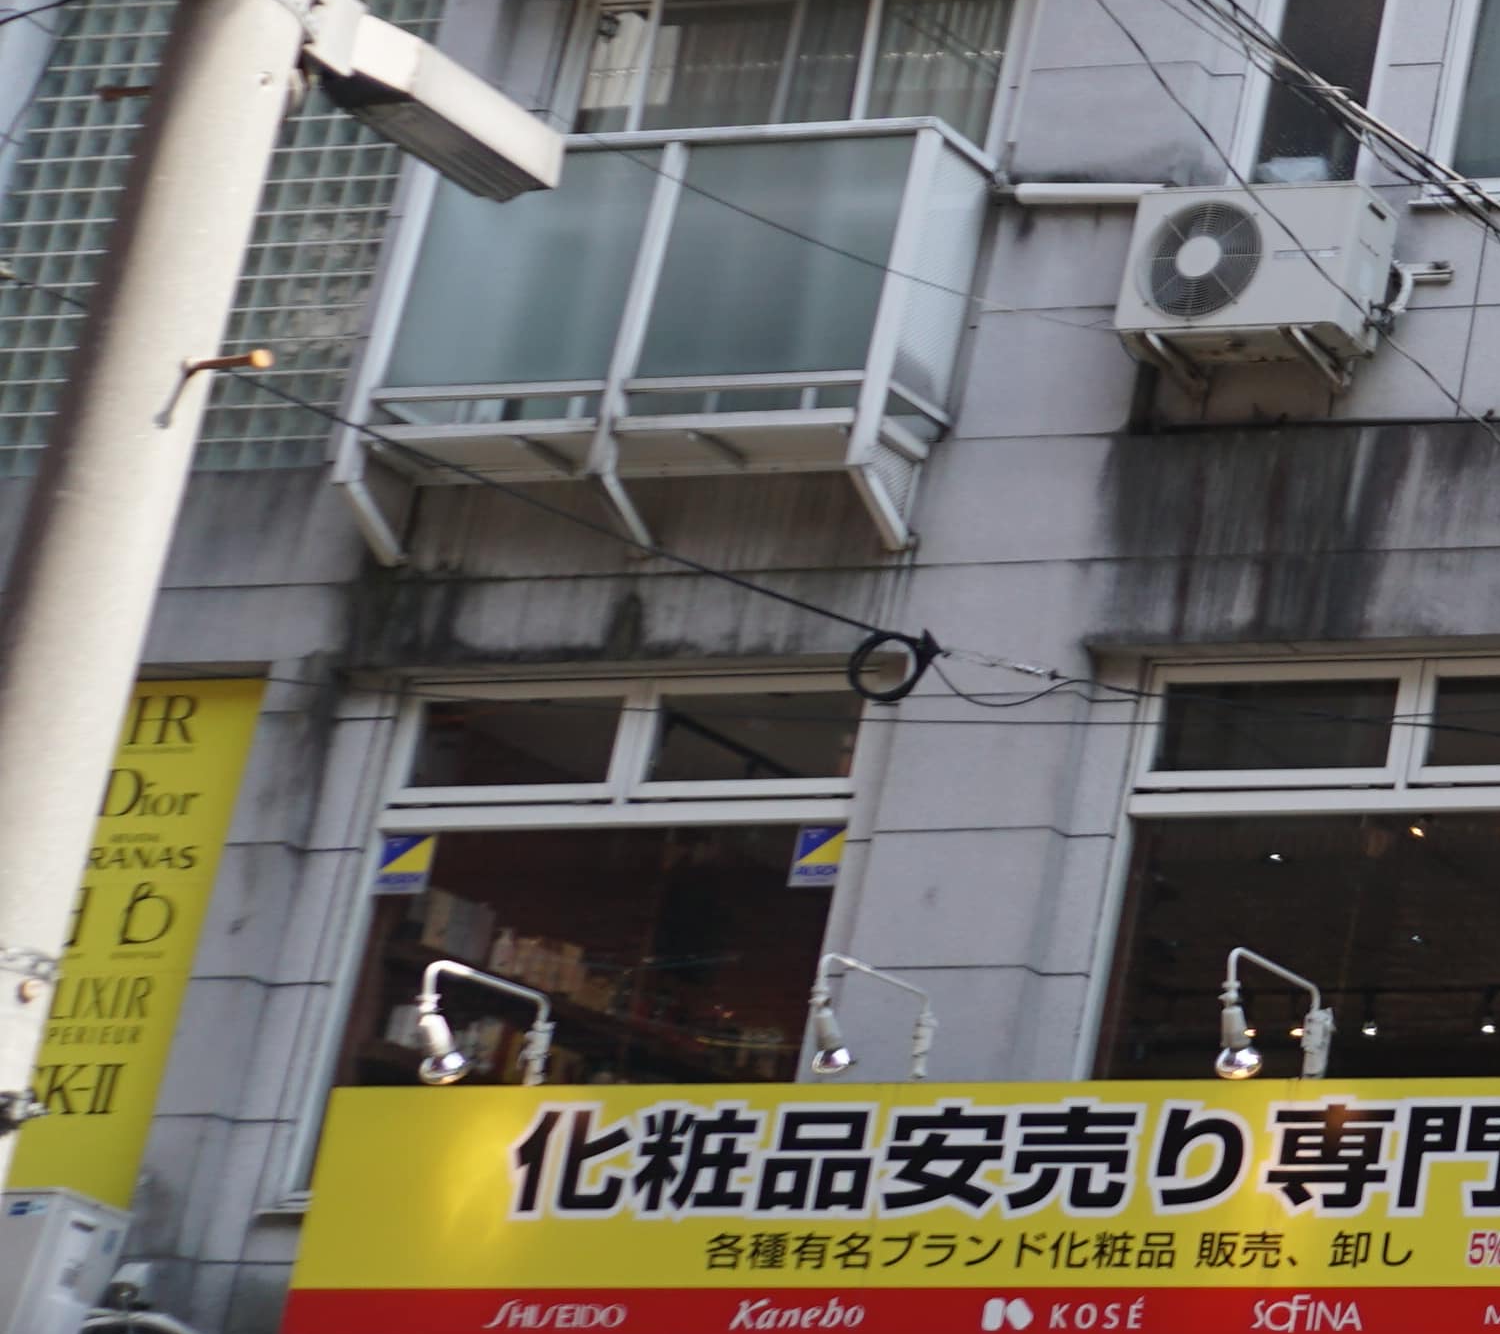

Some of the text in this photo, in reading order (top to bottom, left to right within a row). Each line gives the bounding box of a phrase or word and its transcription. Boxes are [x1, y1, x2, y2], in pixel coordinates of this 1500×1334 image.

[97, 767, 202, 818] Dior
[87, 844, 199, 870] RANAS
[49, 975, 154, 1021] LIXIR
[46, 1024, 145, 1045] PERIEUR
[36, 1062, 127, 1116] K-II
[705, 1230, 1415, 1271] 各種有名ブランド化粧品 販売、卸し
[482, 1300, 629, 1331] SHISEIDO
[729, 1298, 866, 1332] Kanebo
[1049, 1295, 1145, 1331] KOSÉ
